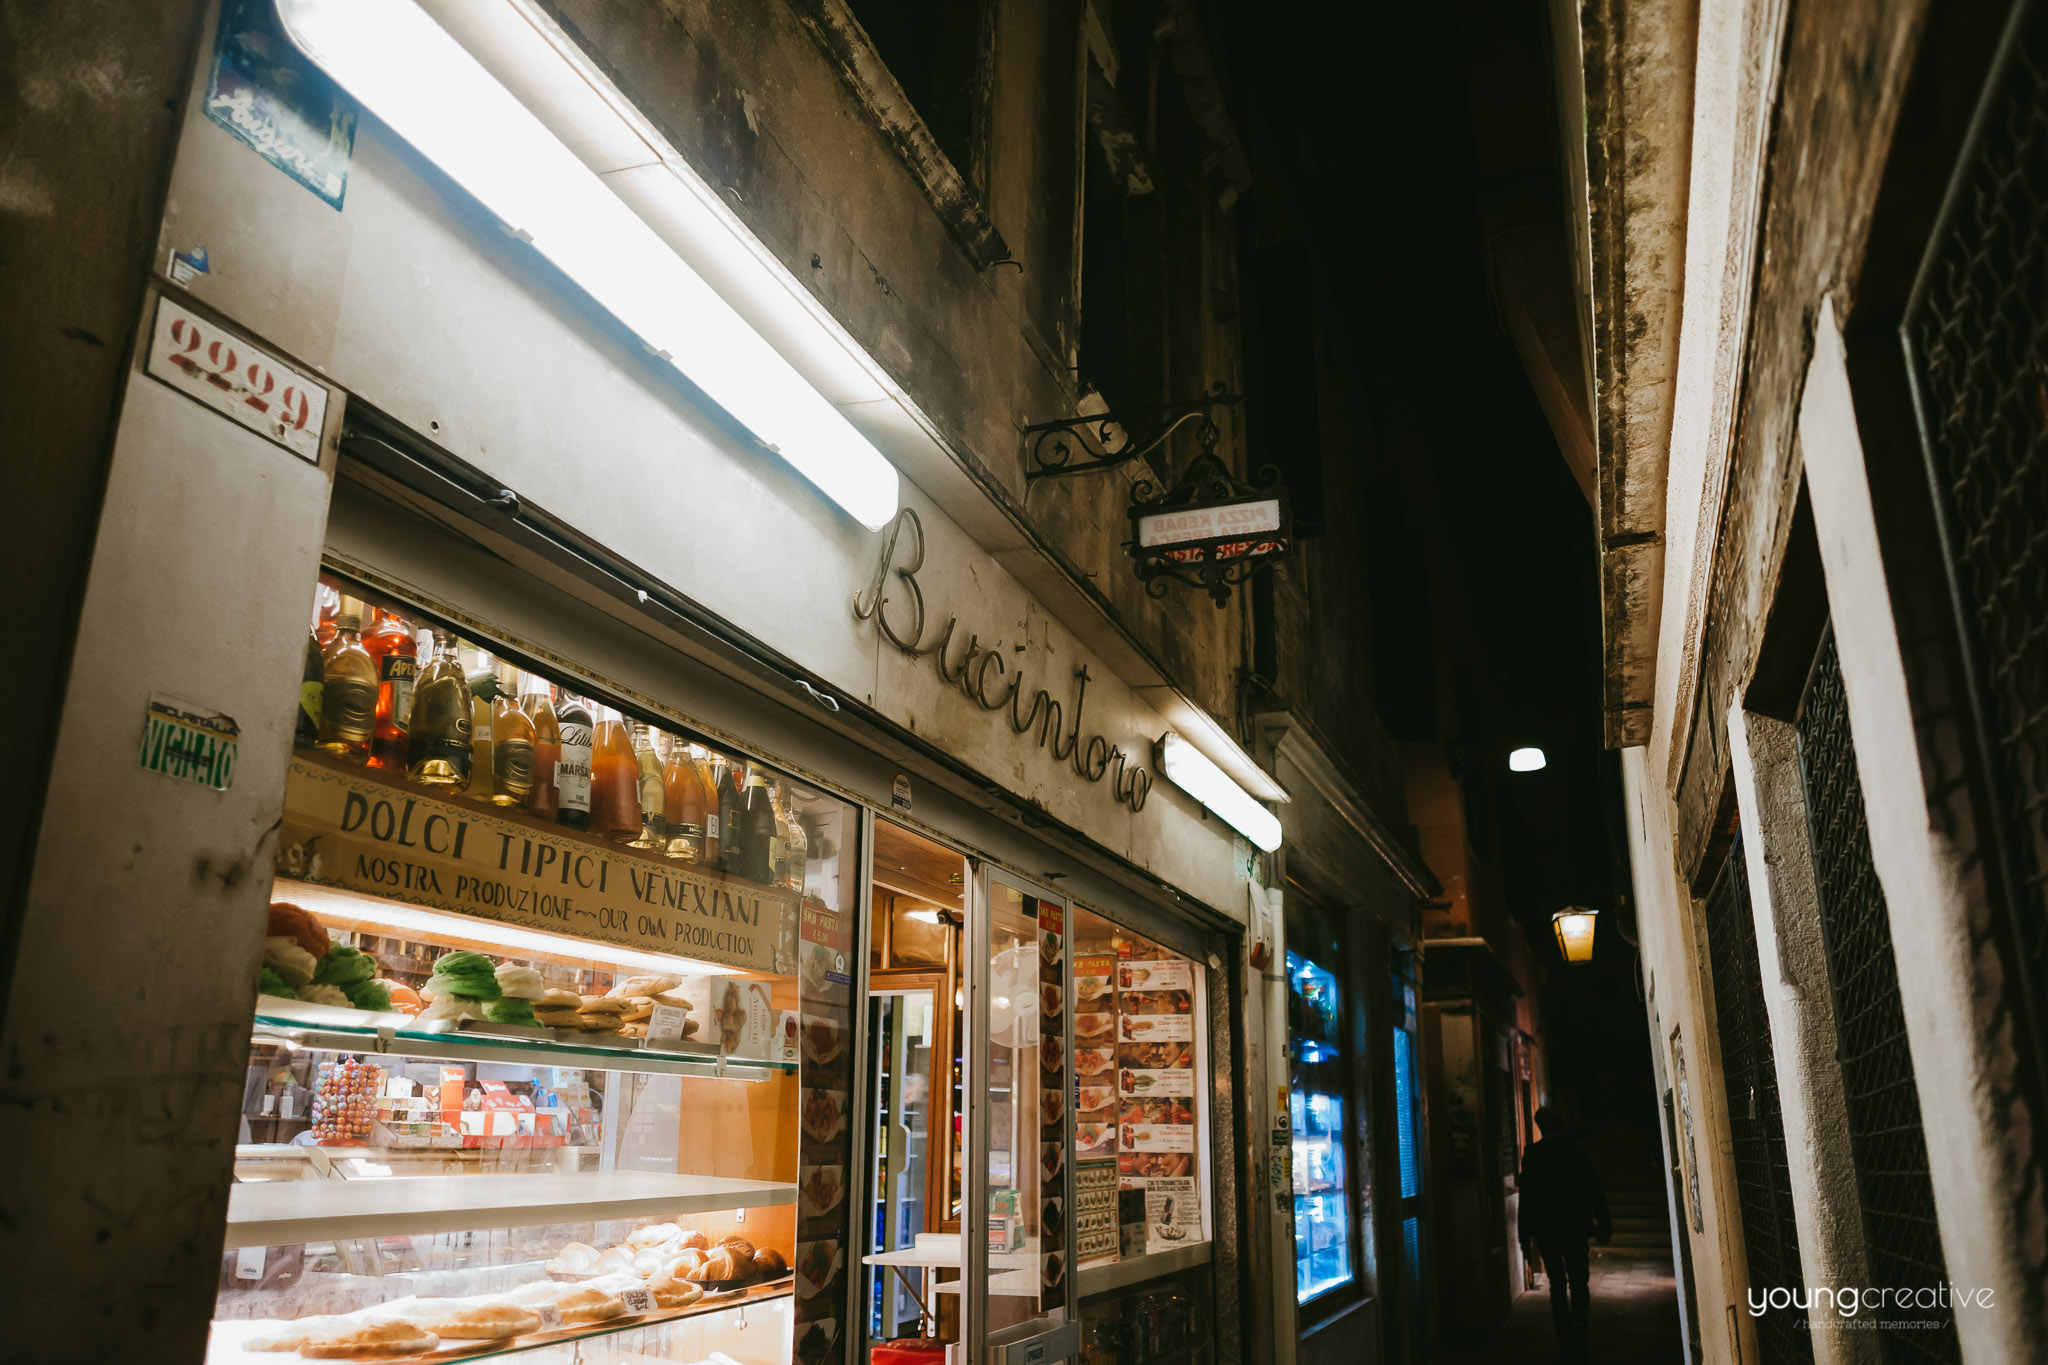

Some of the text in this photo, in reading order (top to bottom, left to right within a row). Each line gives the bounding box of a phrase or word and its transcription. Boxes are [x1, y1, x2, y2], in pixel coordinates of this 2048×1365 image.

[167, 317, 311, 431] 2229
[853, 507, 1153, 813] Bucintoro
[341, 791, 761, 928] DOLCI TIPICI VENEXIANI
[355, 853, 756, 957] NOSTRA PRODUZIONE OUR OWN PRODUCTION
[819, 916, 840, 933] PASTA
